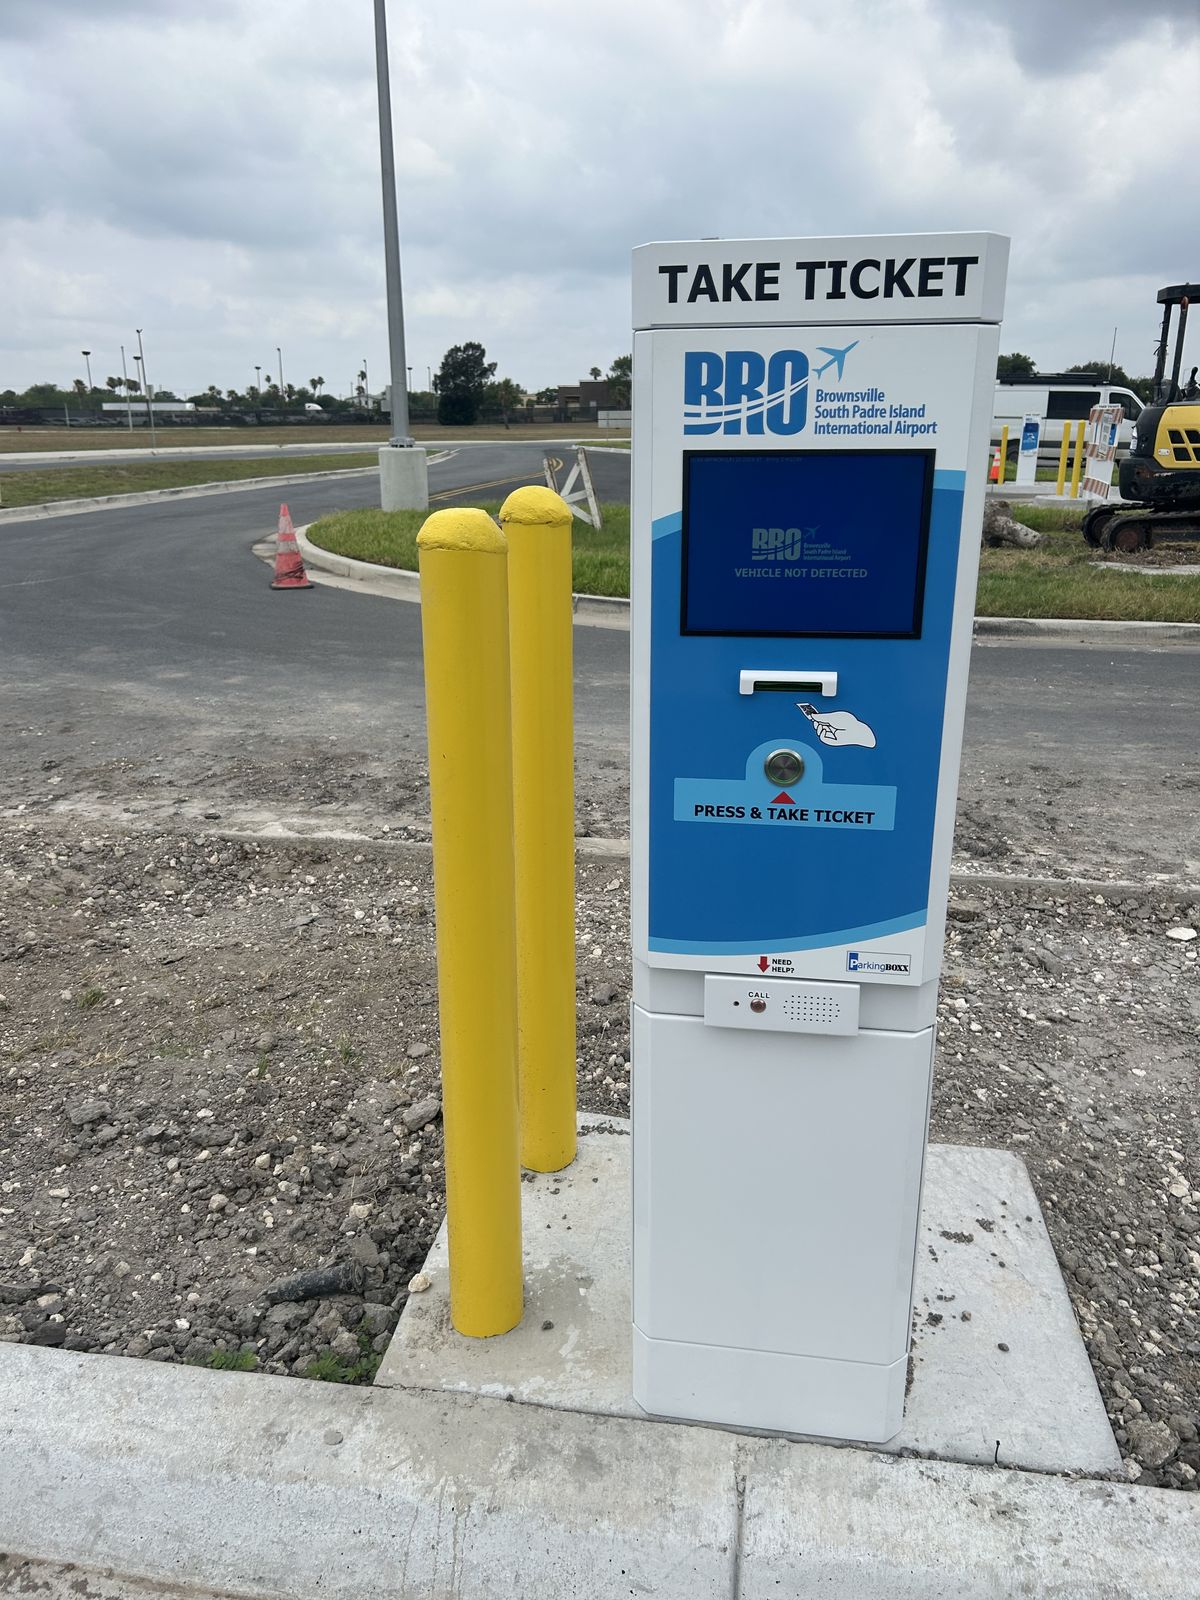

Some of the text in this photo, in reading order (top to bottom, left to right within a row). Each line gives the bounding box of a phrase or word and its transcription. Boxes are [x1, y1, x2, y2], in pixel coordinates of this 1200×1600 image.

[658, 256, 979, 304] TAKE TICKET
[683, 349, 810, 436] BRO
[815, 388, 885, 403] Brownsville
[814, 403, 925, 419] South Padre Island
[814, 420, 938, 438] International Airport
[752, 527, 802, 561] BRO
[735, 568, 868, 578] VEHICLE NOT DETECTED
[694, 804, 875, 824] PRESS & TAKE TICKET
[771, 965, 795, 974] HELP?
[772, 958, 793, 966] NEED
[849, 955, 909, 972] ParkingBOXX
[748, 991, 770, 999] CALL
